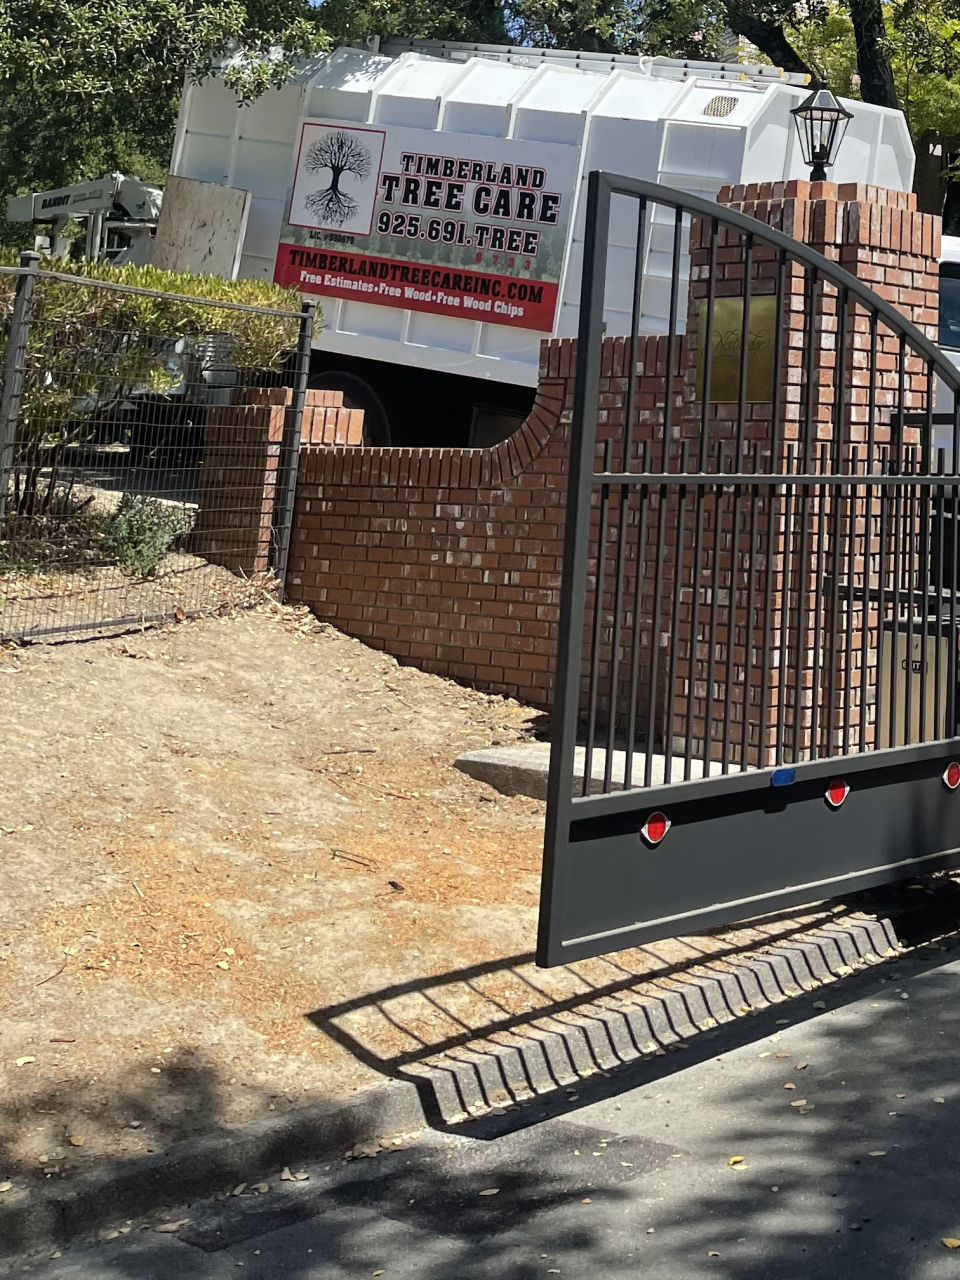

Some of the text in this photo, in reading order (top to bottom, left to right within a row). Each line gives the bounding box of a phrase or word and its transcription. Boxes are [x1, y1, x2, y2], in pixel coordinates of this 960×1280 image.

[401, 152, 547, 189] TIMBERLAND
[41, 194, 71, 209] BANDIT
[380, 173, 561, 225] TREE CARE
[290, 249, 544, 303] TIMBERLANDTREECAREINC.COM
[300, 270, 322, 285] Free
[463, 295, 492, 311] Wood
[493, 300, 525, 318] Chips
